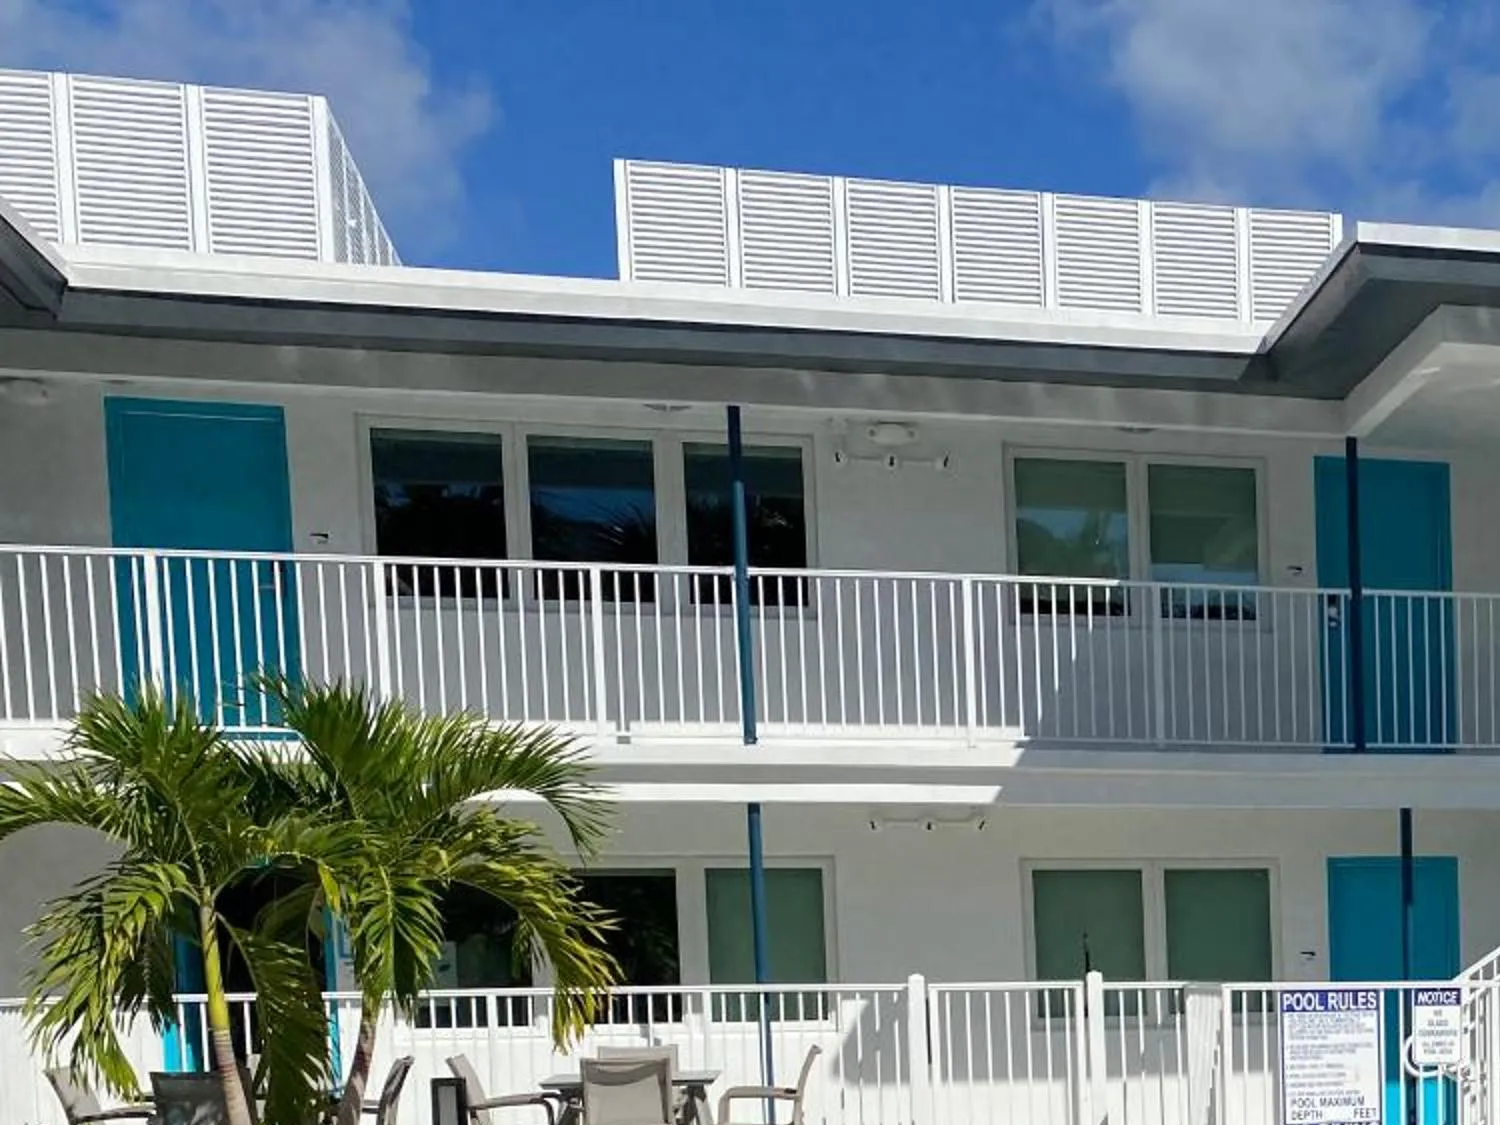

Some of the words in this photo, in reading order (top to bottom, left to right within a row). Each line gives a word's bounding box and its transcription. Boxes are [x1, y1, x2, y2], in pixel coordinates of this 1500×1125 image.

[1283, 992, 1325, 1011] POOL
[1327, 991, 1377, 1010] RULES
[1417, 991, 1458, 1005] NOTICE
[1290, 1097, 1317, 1109] POOL
[1319, 1096, 1365, 1108] MAXIMUM
[1291, 1109, 1323, 1121] DEPTH
[1353, 1107, 1377, 1119] FEET
